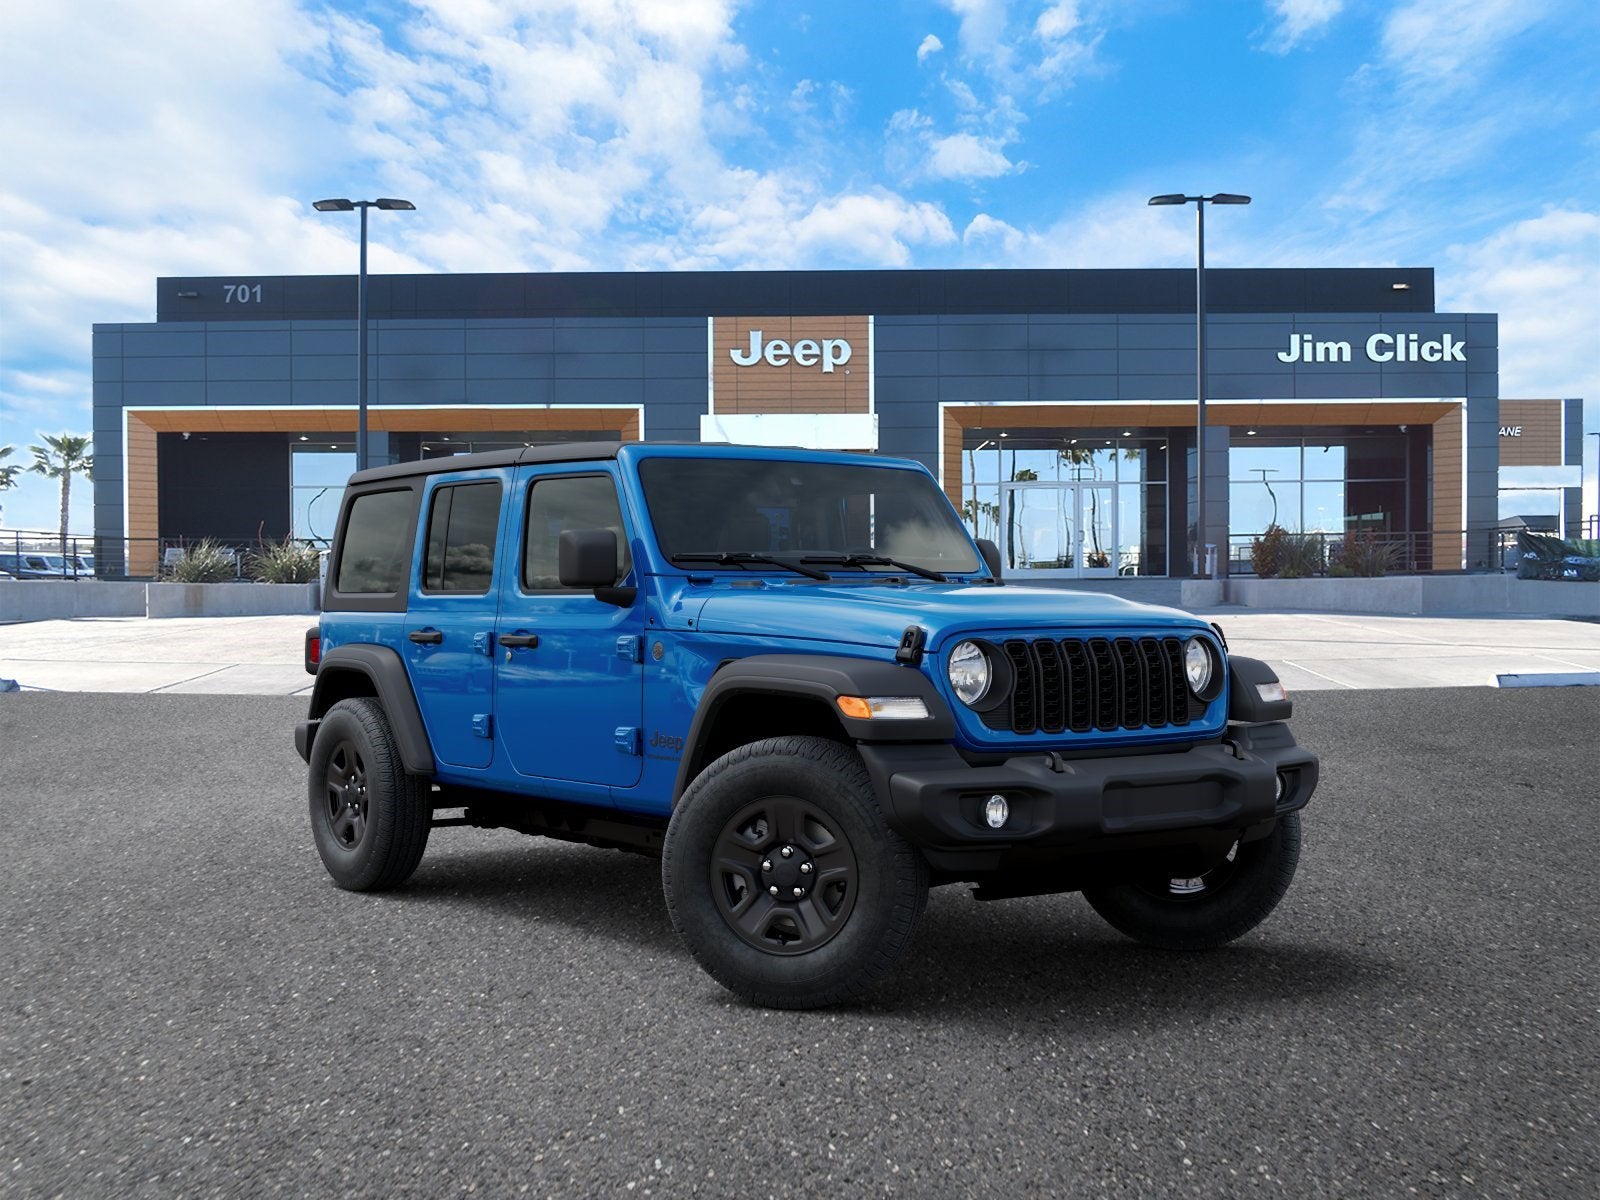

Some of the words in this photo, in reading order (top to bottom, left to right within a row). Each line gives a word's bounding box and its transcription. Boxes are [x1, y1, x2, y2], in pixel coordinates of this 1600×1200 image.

[223, 284, 262, 303] 701
[729, 330, 852, 373] Jeep
[1277, 333, 1352, 363] Jim
[1366, 333, 1467, 363] Click
[650, 729, 683, 753] Jeep
